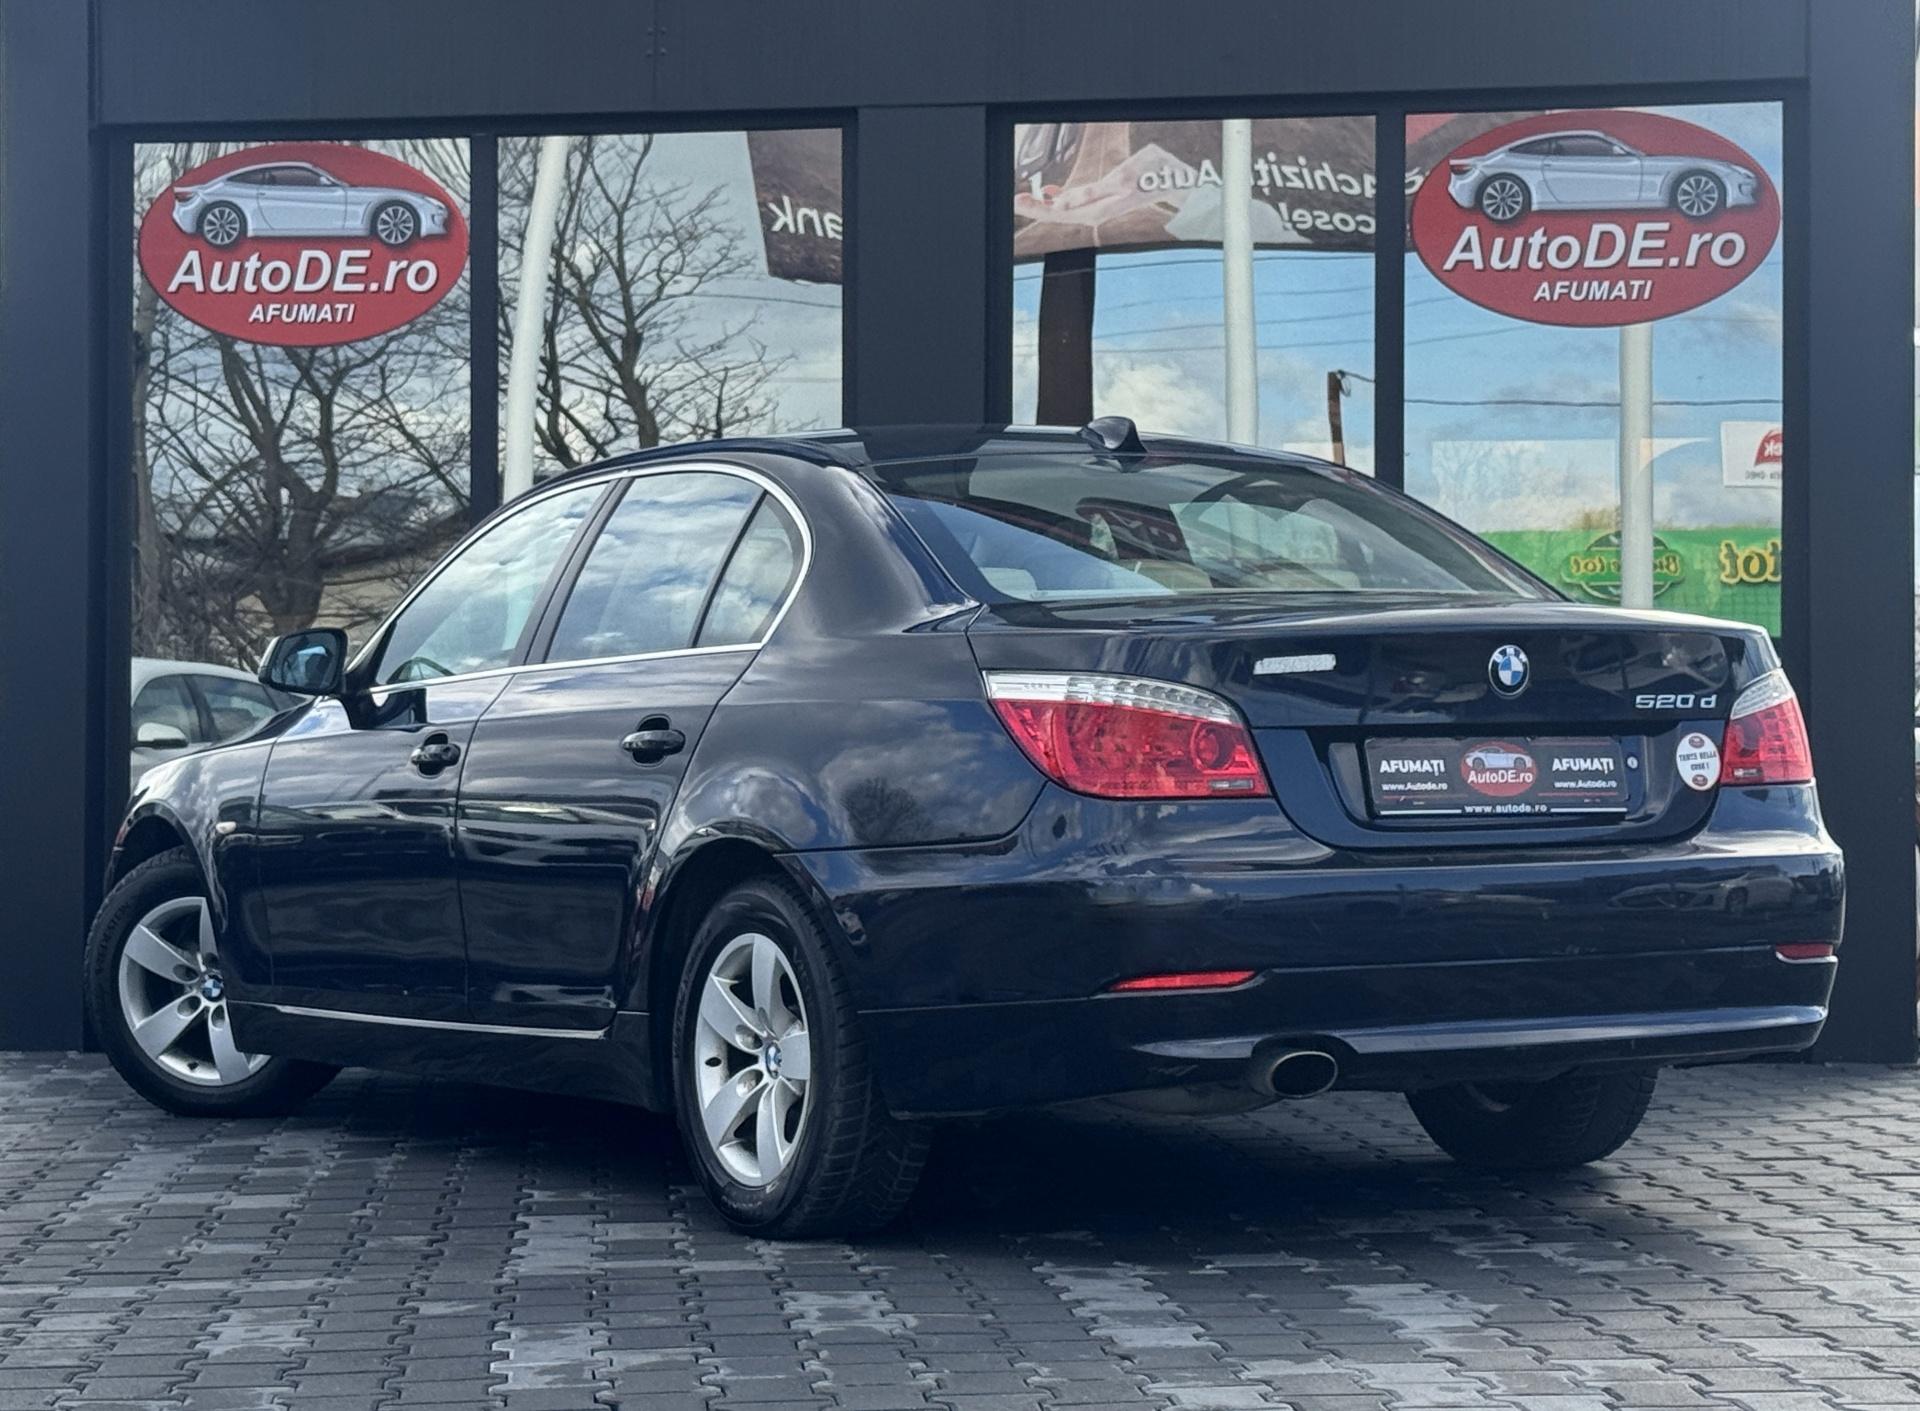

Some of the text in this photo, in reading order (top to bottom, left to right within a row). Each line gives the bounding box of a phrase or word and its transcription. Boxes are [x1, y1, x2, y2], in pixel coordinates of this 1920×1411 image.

[1442, 222, 1746, 271] AutoDE.ro
[167, 249, 438, 293] AutoDE.ro
[1533, 279, 1654, 302] AFUMATI
[248, 303, 355, 324] AFUMATI
[1635, 694, 1718, 709] 520 d
[1467, 769, 1533, 784] AutoDE.ro
[1381, 782, 1448, 791] www.Autode.ro
[1464, 802, 1548, 813] www.autode.ro
